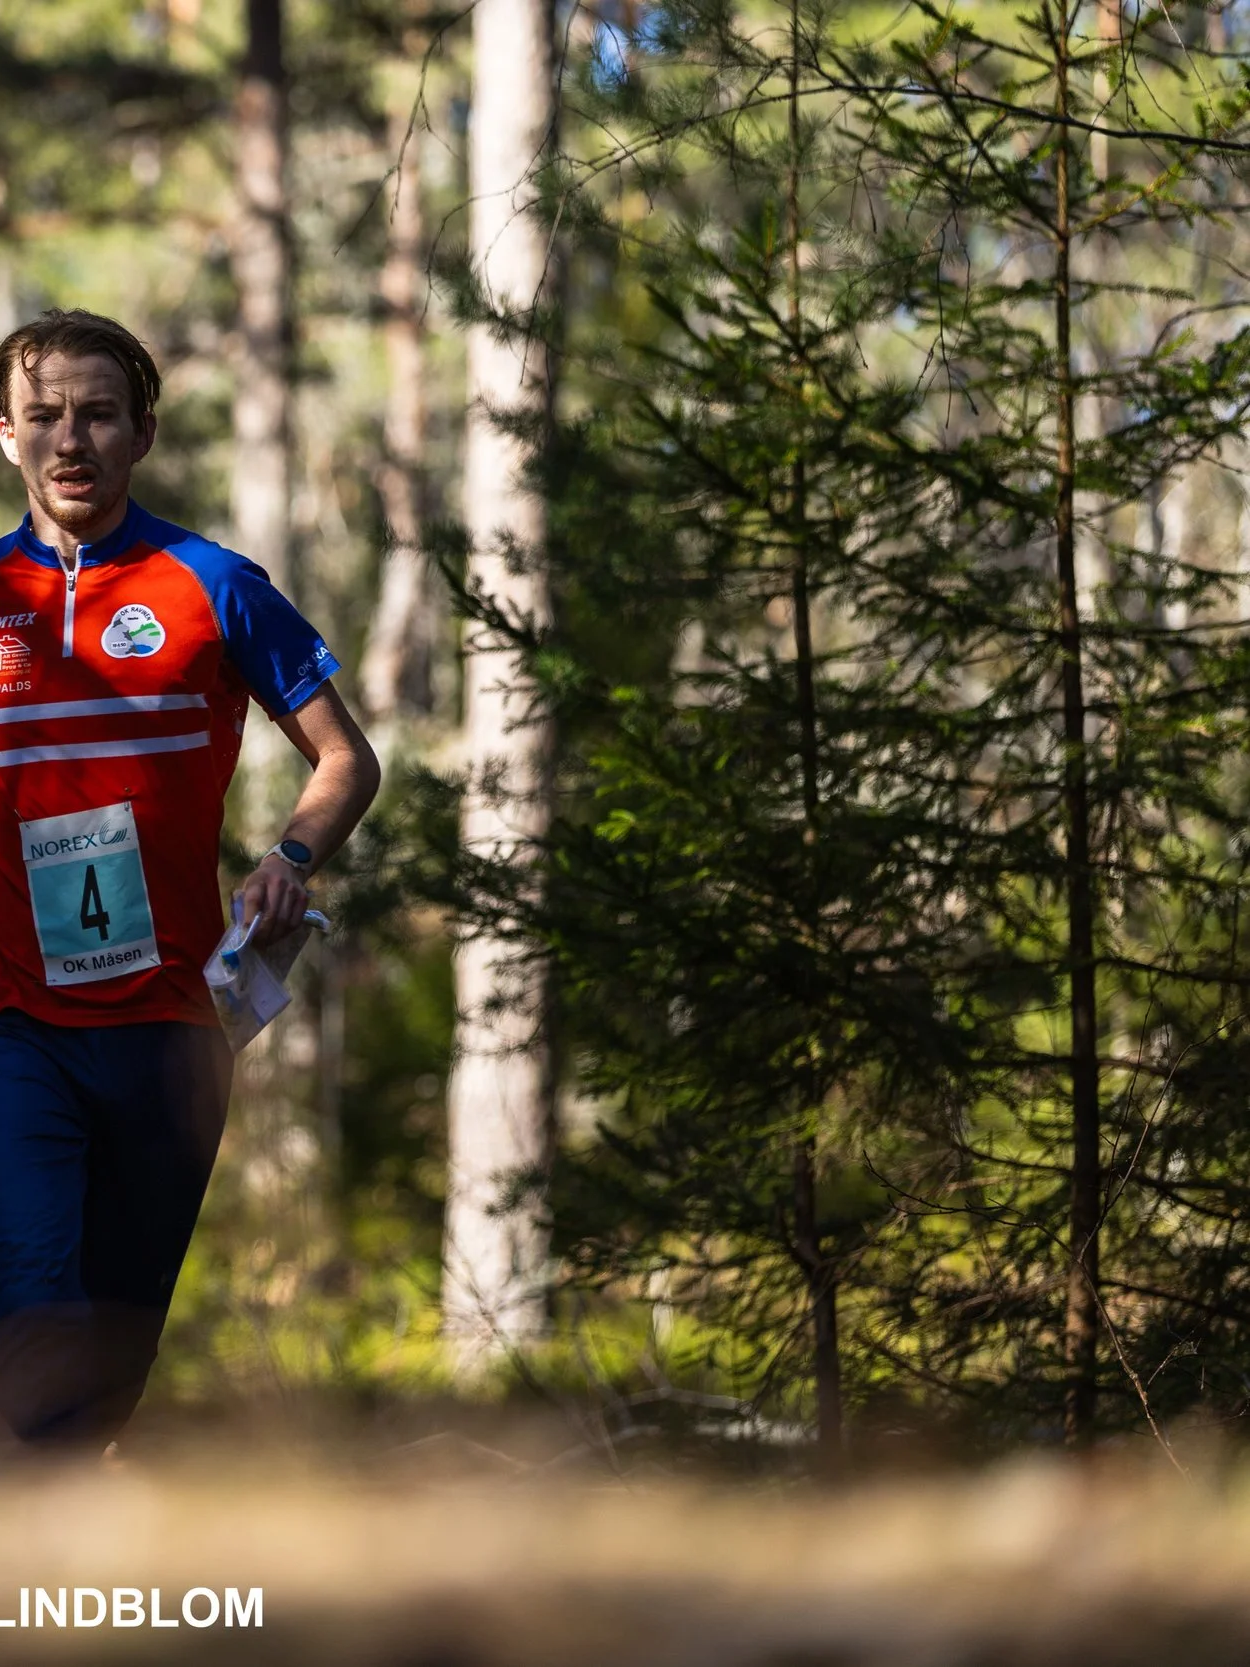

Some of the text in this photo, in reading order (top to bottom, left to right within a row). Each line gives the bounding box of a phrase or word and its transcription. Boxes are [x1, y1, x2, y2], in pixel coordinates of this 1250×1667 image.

[297, 645, 330, 676] OK RA
[30, 833, 98, 859] NOREX
[80, 864, 110, 941] 4
[63, 948, 142, 974] OK Måsen
